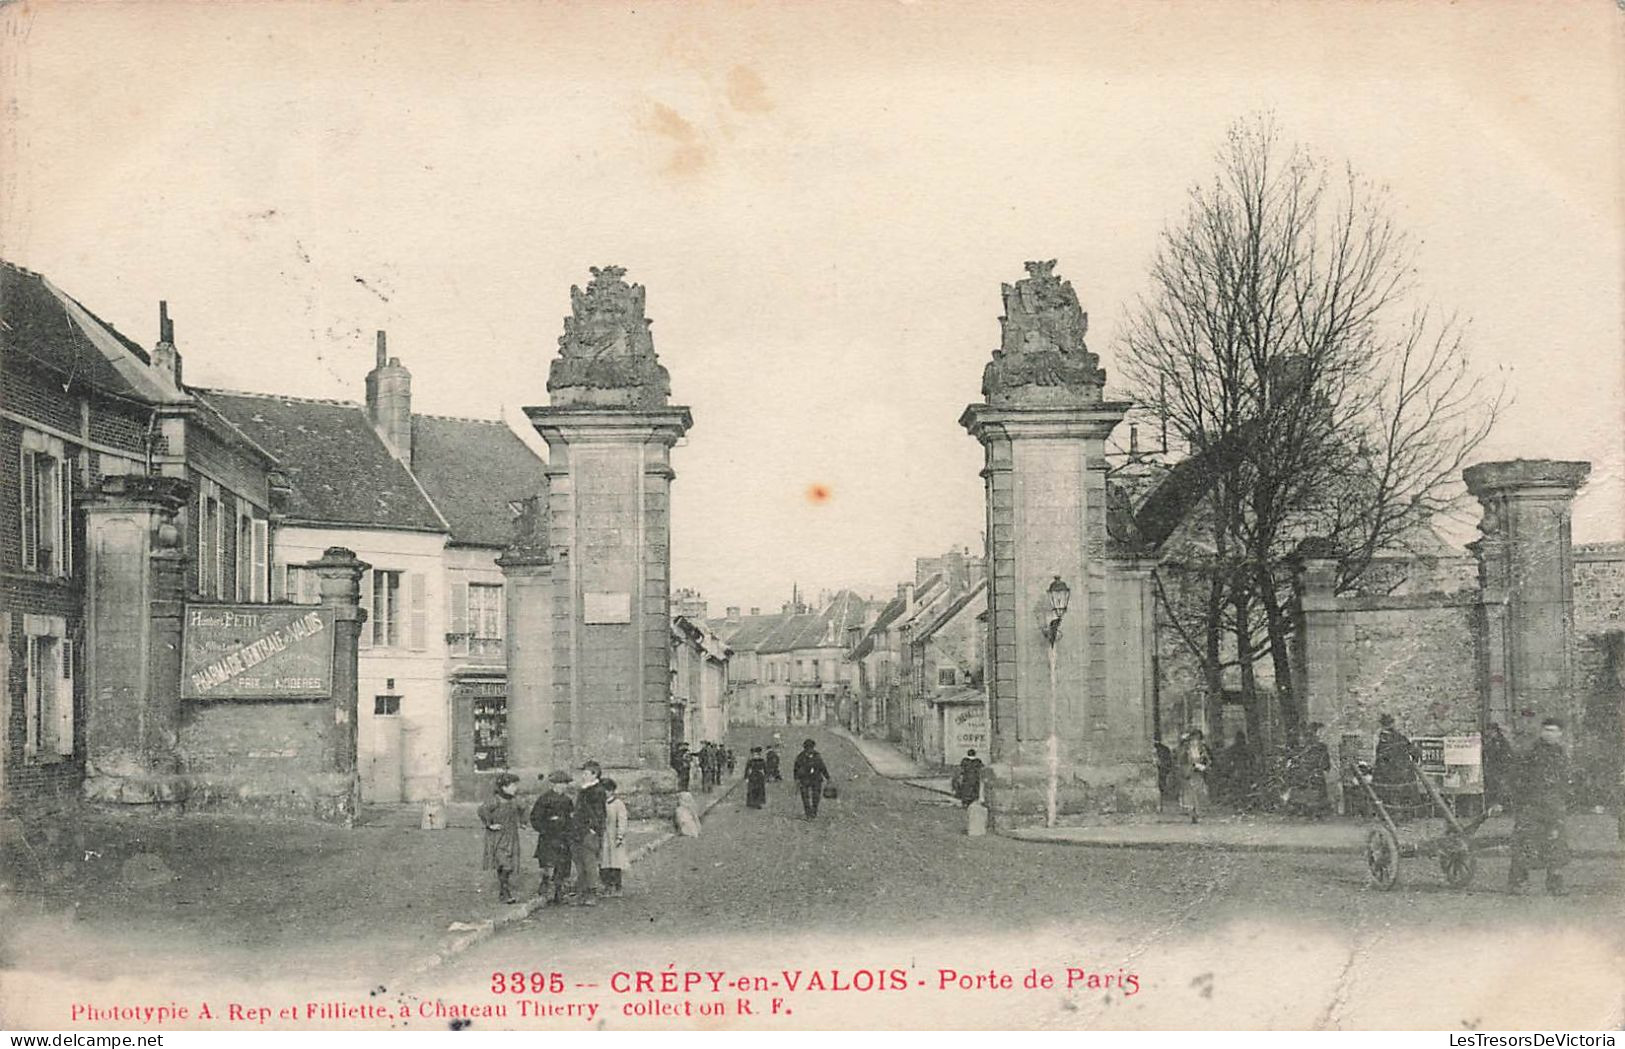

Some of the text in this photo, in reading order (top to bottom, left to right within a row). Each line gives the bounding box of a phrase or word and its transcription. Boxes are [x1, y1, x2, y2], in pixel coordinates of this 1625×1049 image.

[191, 651, 247, 694] PHARMACIE
[239, 630, 288, 669] CENTRALE
[286, 611, 324, 642] VALOIS
[490, 971, 564, 994] 3395
[610, 963, 908, 993] CRÉPY-en-VALOIS
[938, 969, 1013, 990] Porte
[1023, 967, 1054, 989] de
[1066, 967, 1140, 997] Paris
[71, 1003, 189, 1023] Phototypie
[228, 1004, 271, 1024] Rep
[279, 1006, 298, 1019] et
[306, 1002, 395, 1021] Filliette,
[419, 1000, 507, 1018] Chateau
[517, 999, 599, 1020] Thierry
[771, 998, 792, 1015] F.
